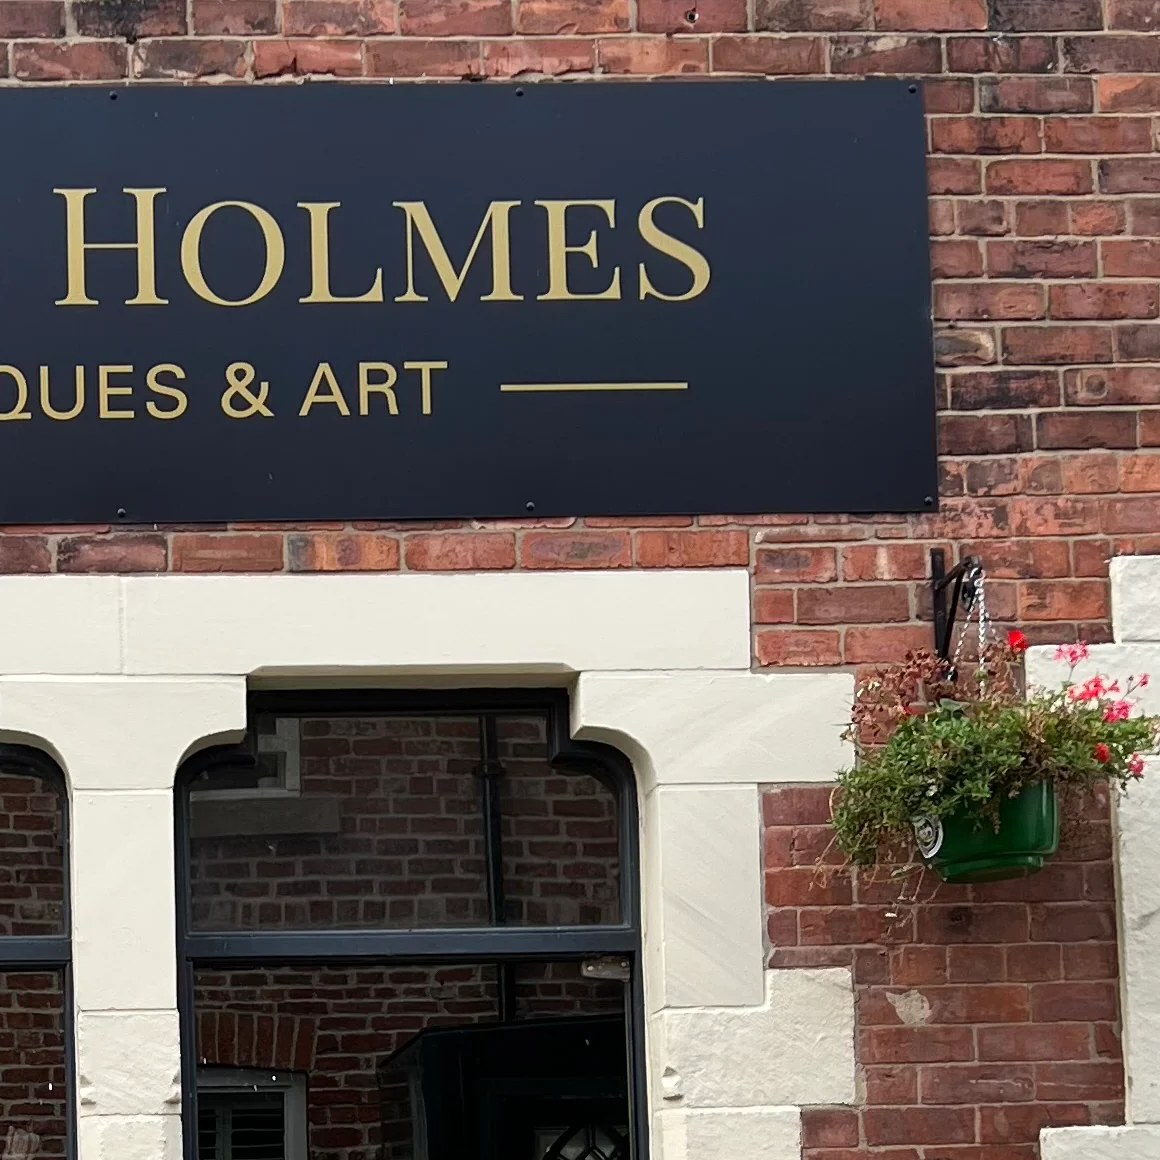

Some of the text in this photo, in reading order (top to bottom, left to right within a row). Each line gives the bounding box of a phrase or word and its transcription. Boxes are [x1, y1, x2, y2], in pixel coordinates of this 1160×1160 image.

[53, 187, 710, 306] HOLMES
[221, 361, 273, 418] &
[299, 361, 448, 416] ART
